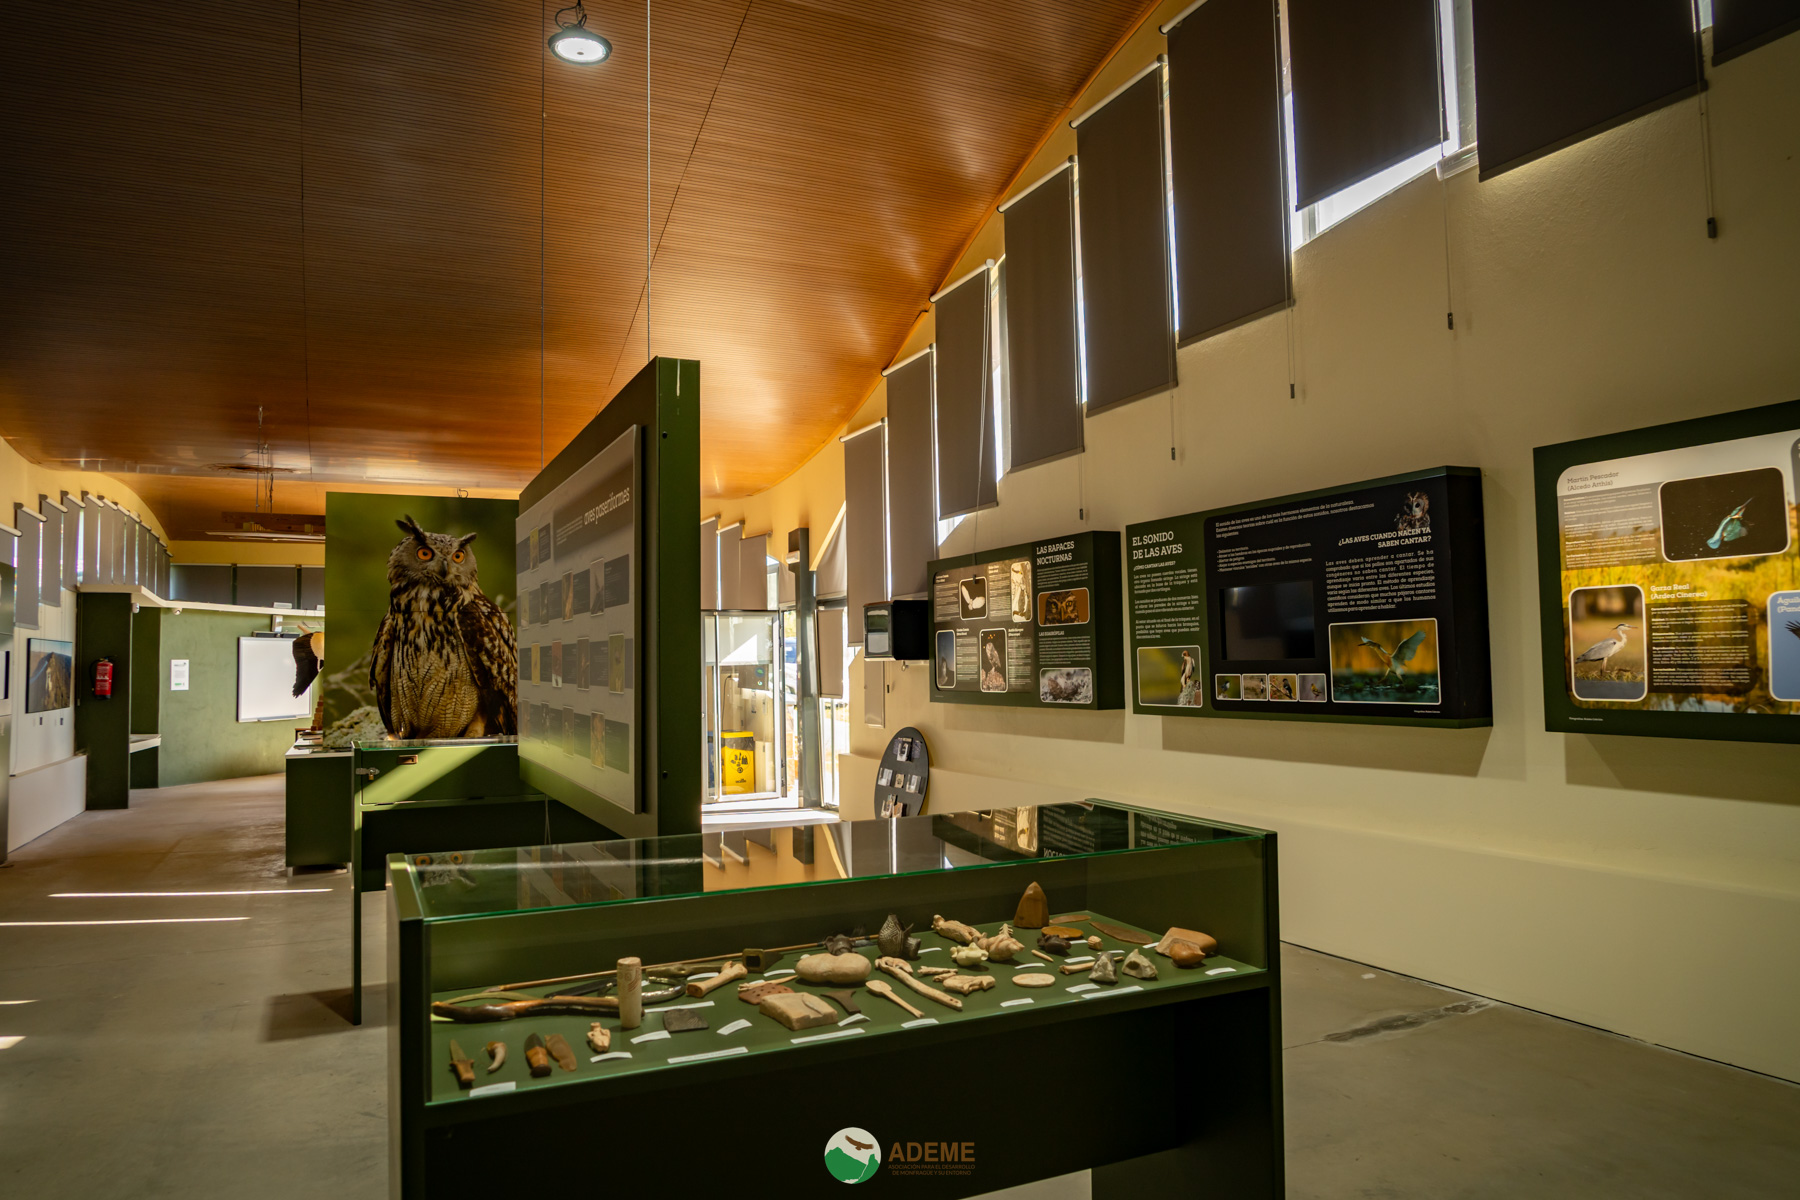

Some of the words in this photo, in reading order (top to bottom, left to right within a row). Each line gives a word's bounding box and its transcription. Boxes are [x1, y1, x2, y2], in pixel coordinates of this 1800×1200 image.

[1589, 472, 1618, 480] Pescador
[1132, 536, 1142, 546] EL
[1143, 531, 1174, 544] SONIDO
[1338, 537, 1353, 546] ¿LAS
[1370, 531, 1397, 540] CUANDO
[1398, 527, 1420, 536] NACEN
[1378, 539, 1399, 548] SABEN
[1400, 535, 1431, 545] CANTAR?
[1036, 546, 1047, 554] LAS
[1048, 541, 1074, 552] RAPACES
[1133, 549, 1143, 559] DE
[1144, 547, 1160, 558] LAS
[1161, 543, 1182, 555] AVES
[1037, 553, 1072, 565] NOCTURNAS
[1676, 590, 1707, 598] Cinerea)
